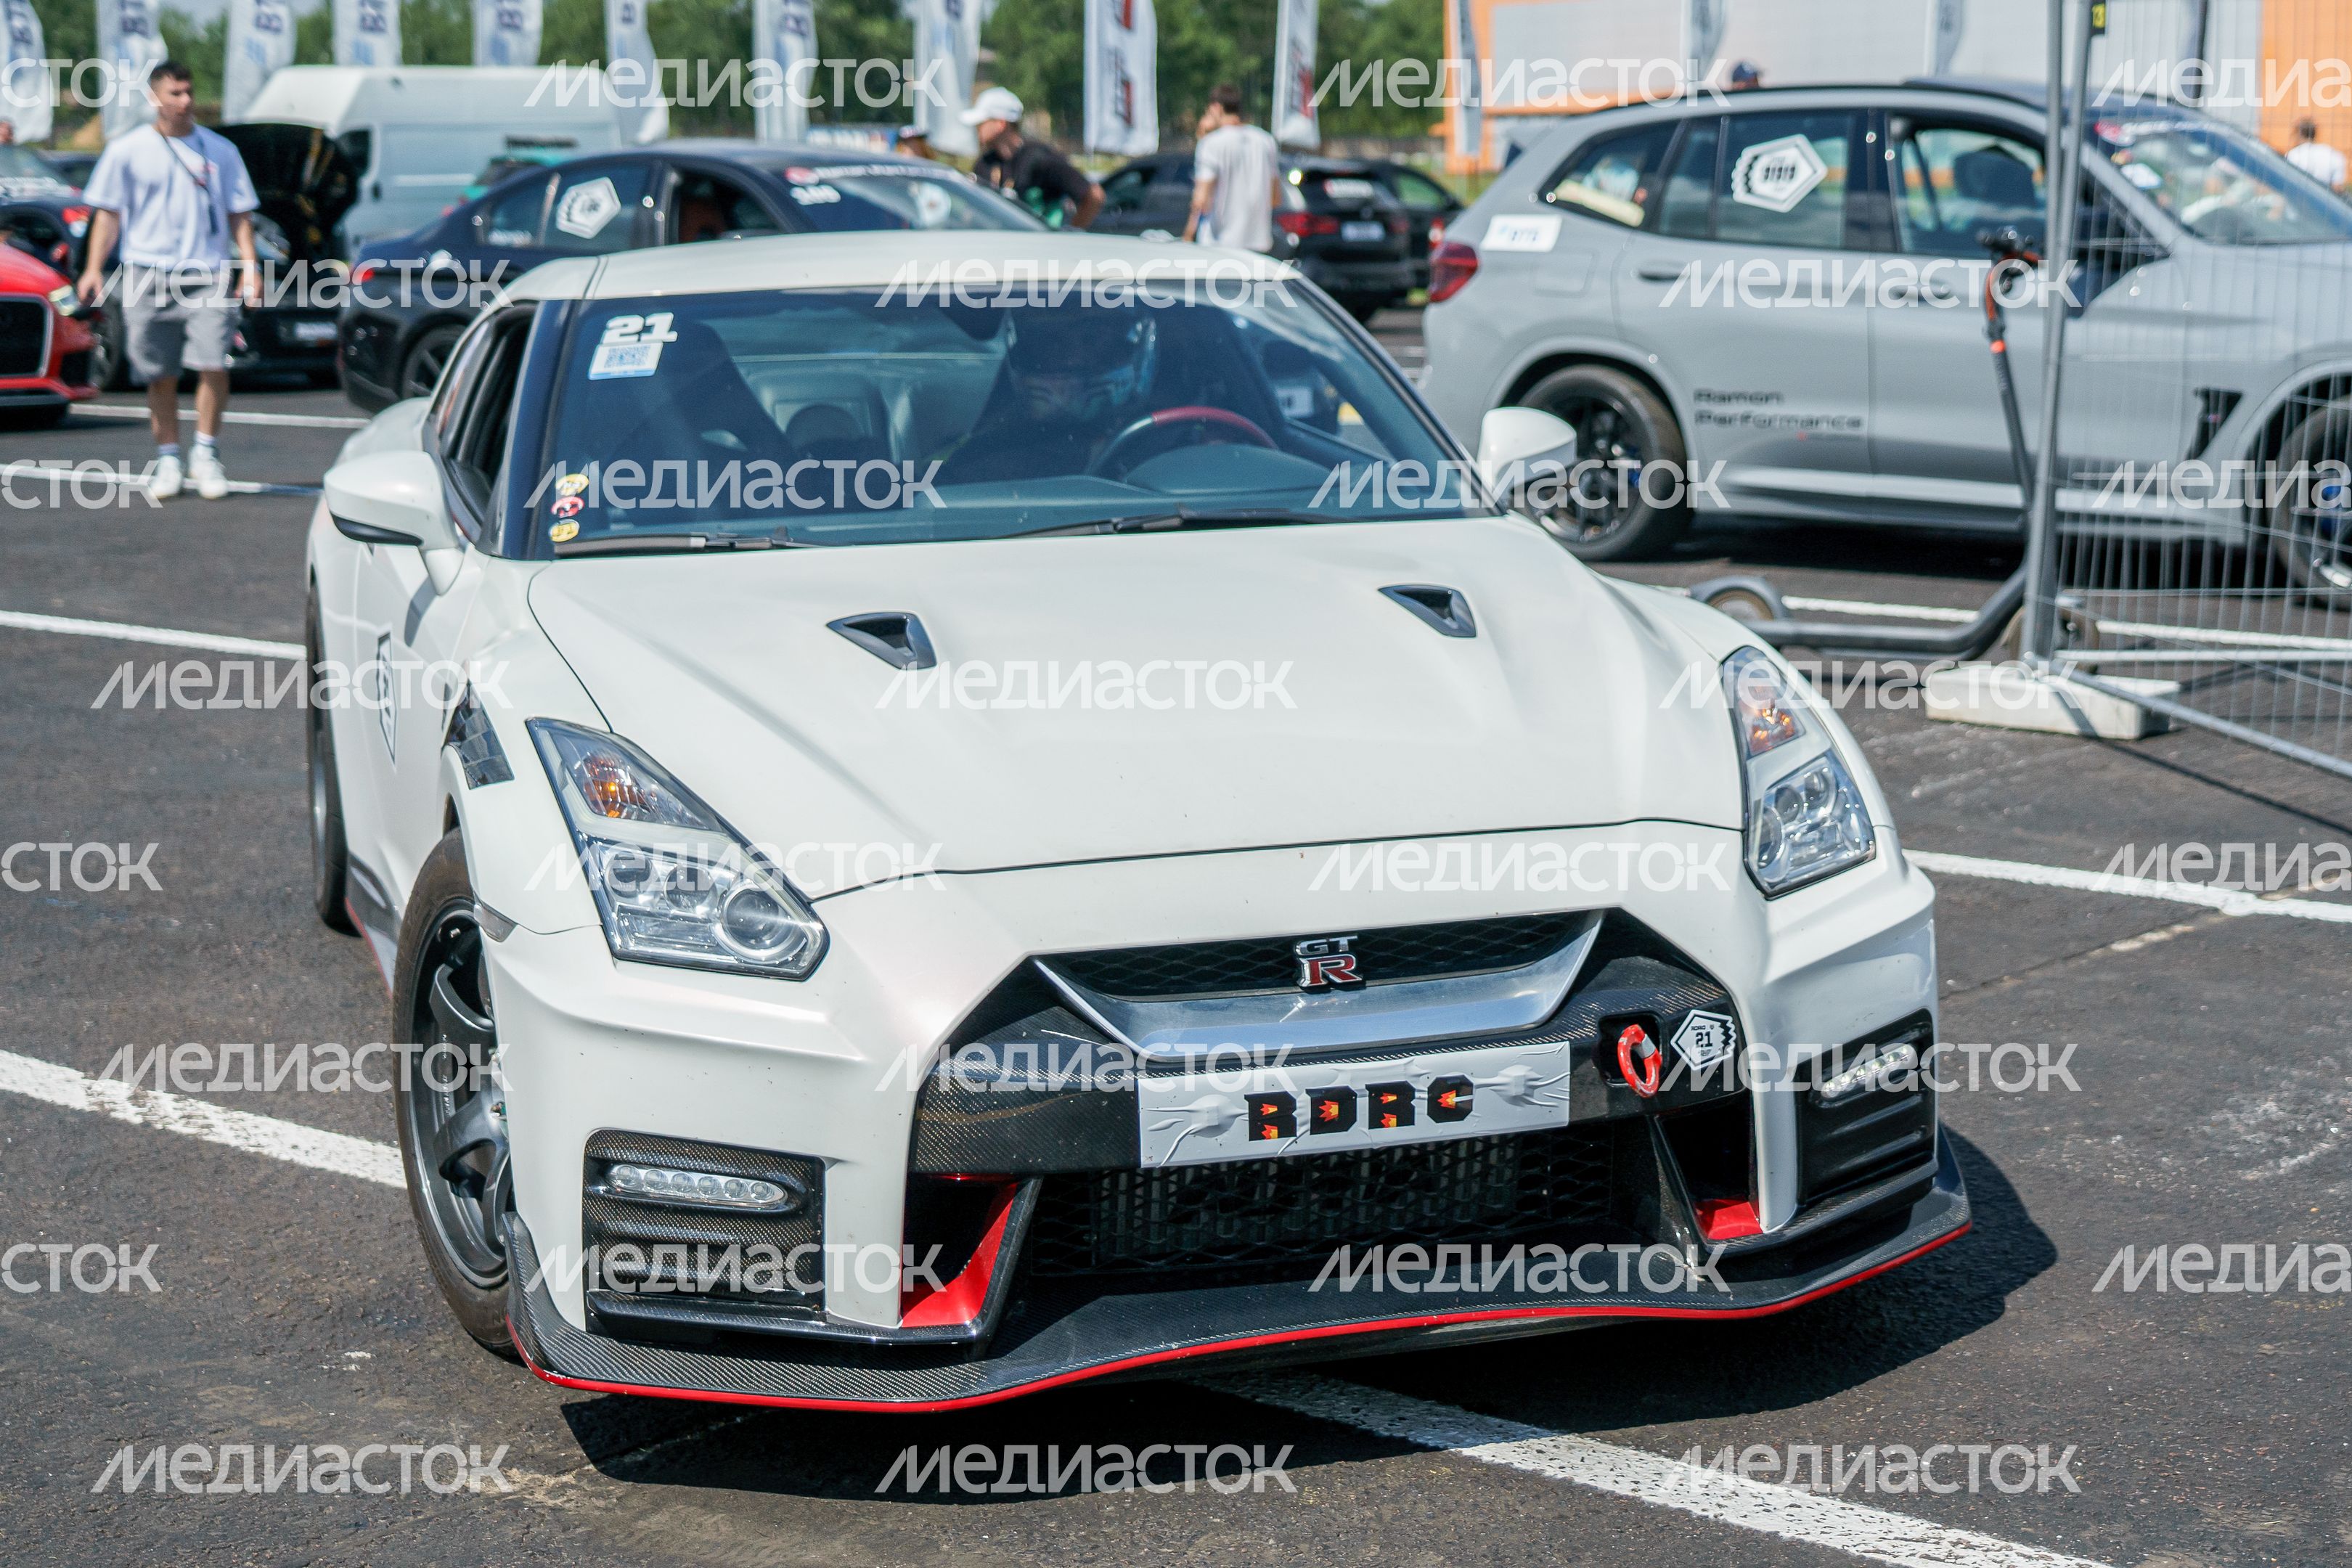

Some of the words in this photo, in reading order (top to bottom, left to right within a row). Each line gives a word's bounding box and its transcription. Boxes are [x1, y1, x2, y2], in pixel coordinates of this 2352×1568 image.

[600, 312, 678, 344] 21
[1695, 1031, 1713, 1048] 21
[1244, 1074, 1474, 1143] RDRC
